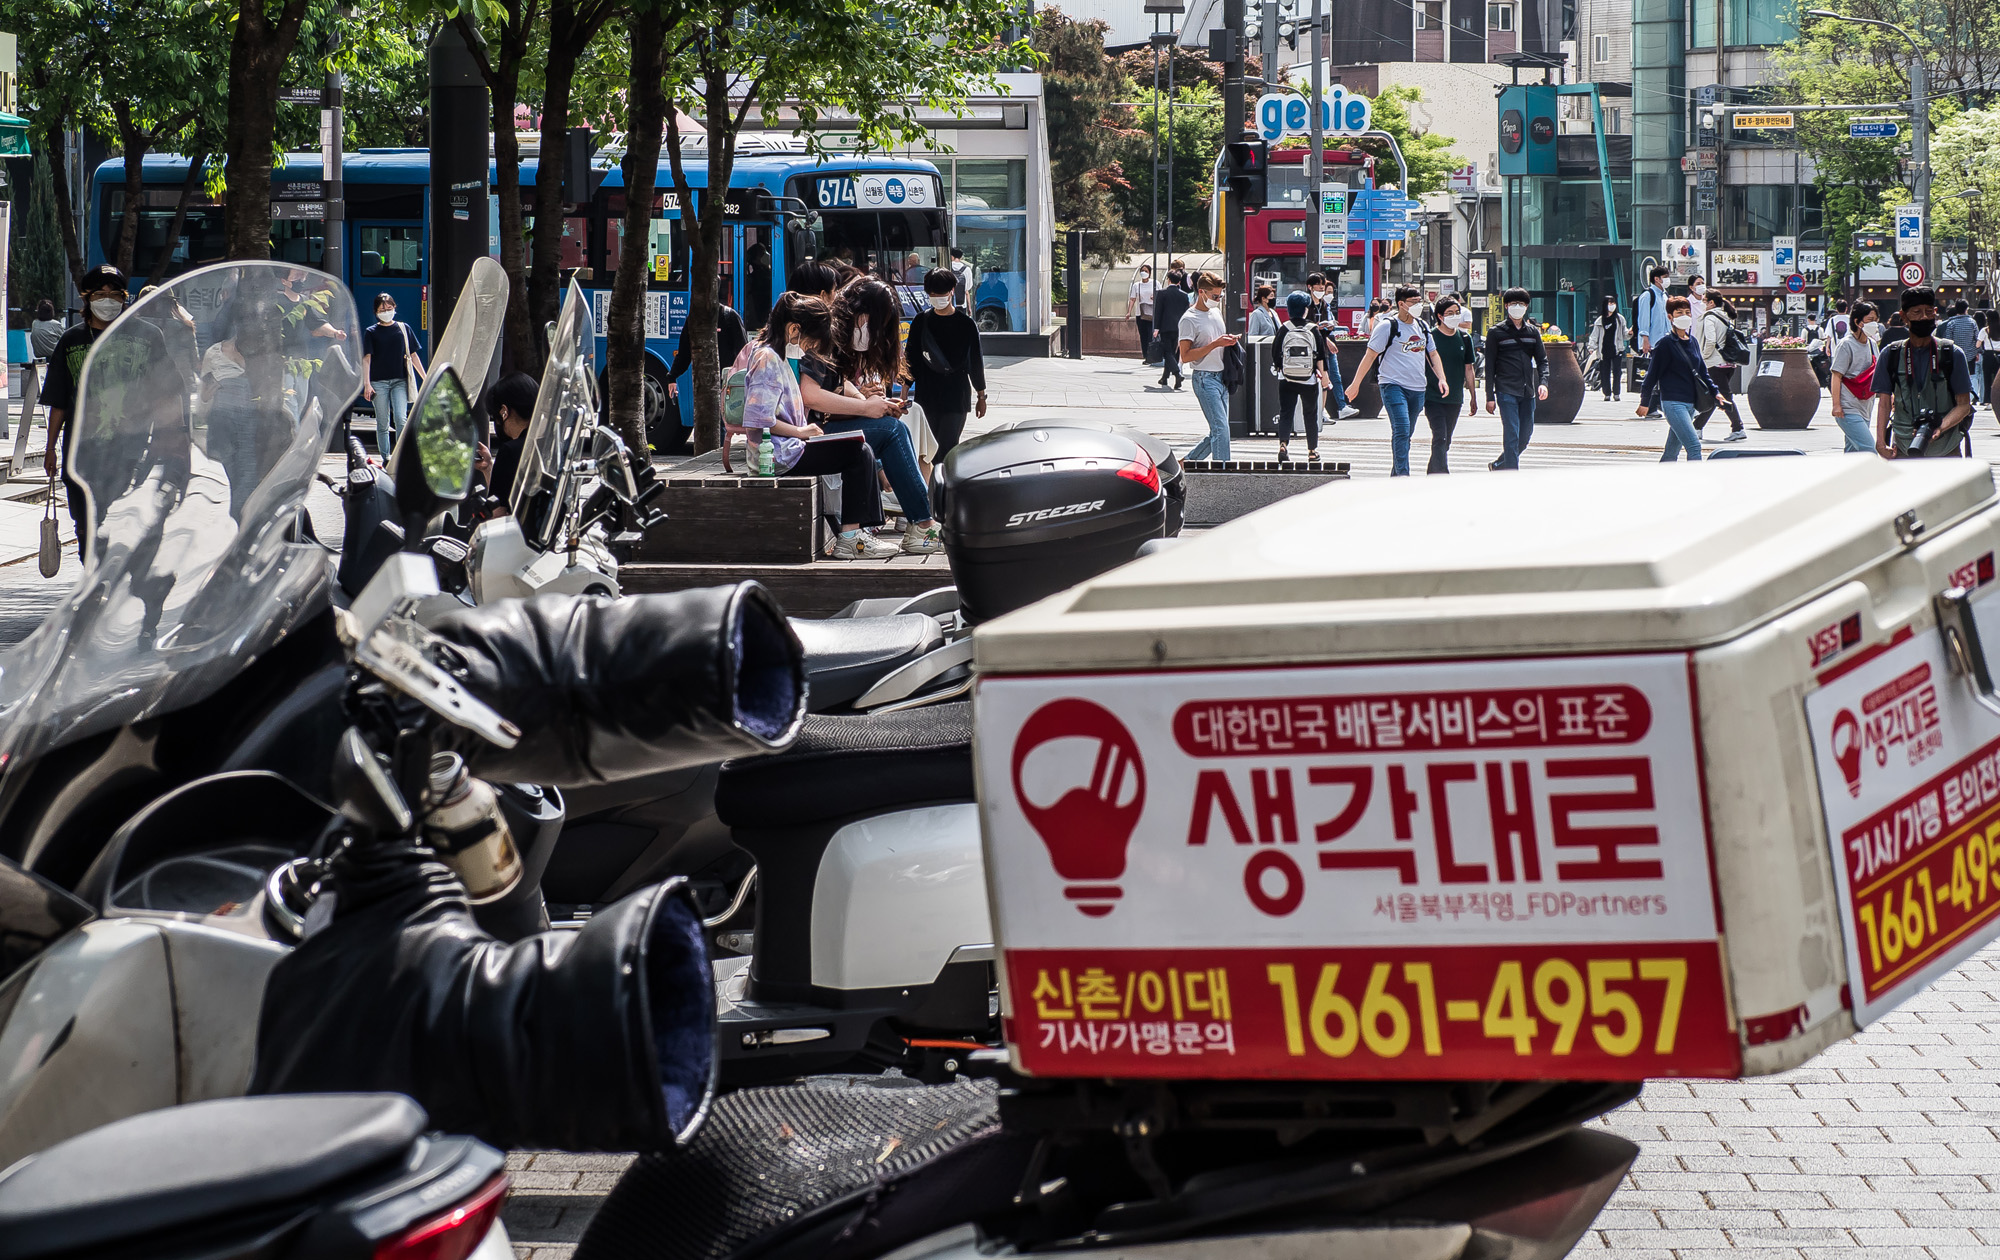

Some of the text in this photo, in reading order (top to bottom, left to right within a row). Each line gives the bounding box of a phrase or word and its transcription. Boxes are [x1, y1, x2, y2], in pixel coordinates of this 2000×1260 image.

[1737, 118, 1747, 126] 불법
[663, 194, 682, 209] 674
[819, 178, 855, 206] 674
[865, 186, 884, 197] 신월동
[888, 186, 904, 197] 목동
[908, 186, 925, 197] 신촌역
[724, 203, 740, 215] 382
[1324, 202, 1343, 213] 보통
[1906, 269, 1919, 280] 30
[672, 296, 684, 305] 674
[1005, 499, 1106, 527] STEEZER
[1192, 694, 1631, 753] 대한민국 배달서비스의 표준
[1864, 685, 1940, 767] 생각대로
[1187, 756, 1665, 917] 생각대로
[1849, 789, 1942, 882] 기사/가맹
[1373, 890, 1669, 923] 서울북부직영_FDPartners
[1031, 968, 1234, 1022] 신촌/이대
[1268, 956, 1689, 1058] 1661-4957
[1038, 1022, 1236, 1057] 기사/가맹문의
